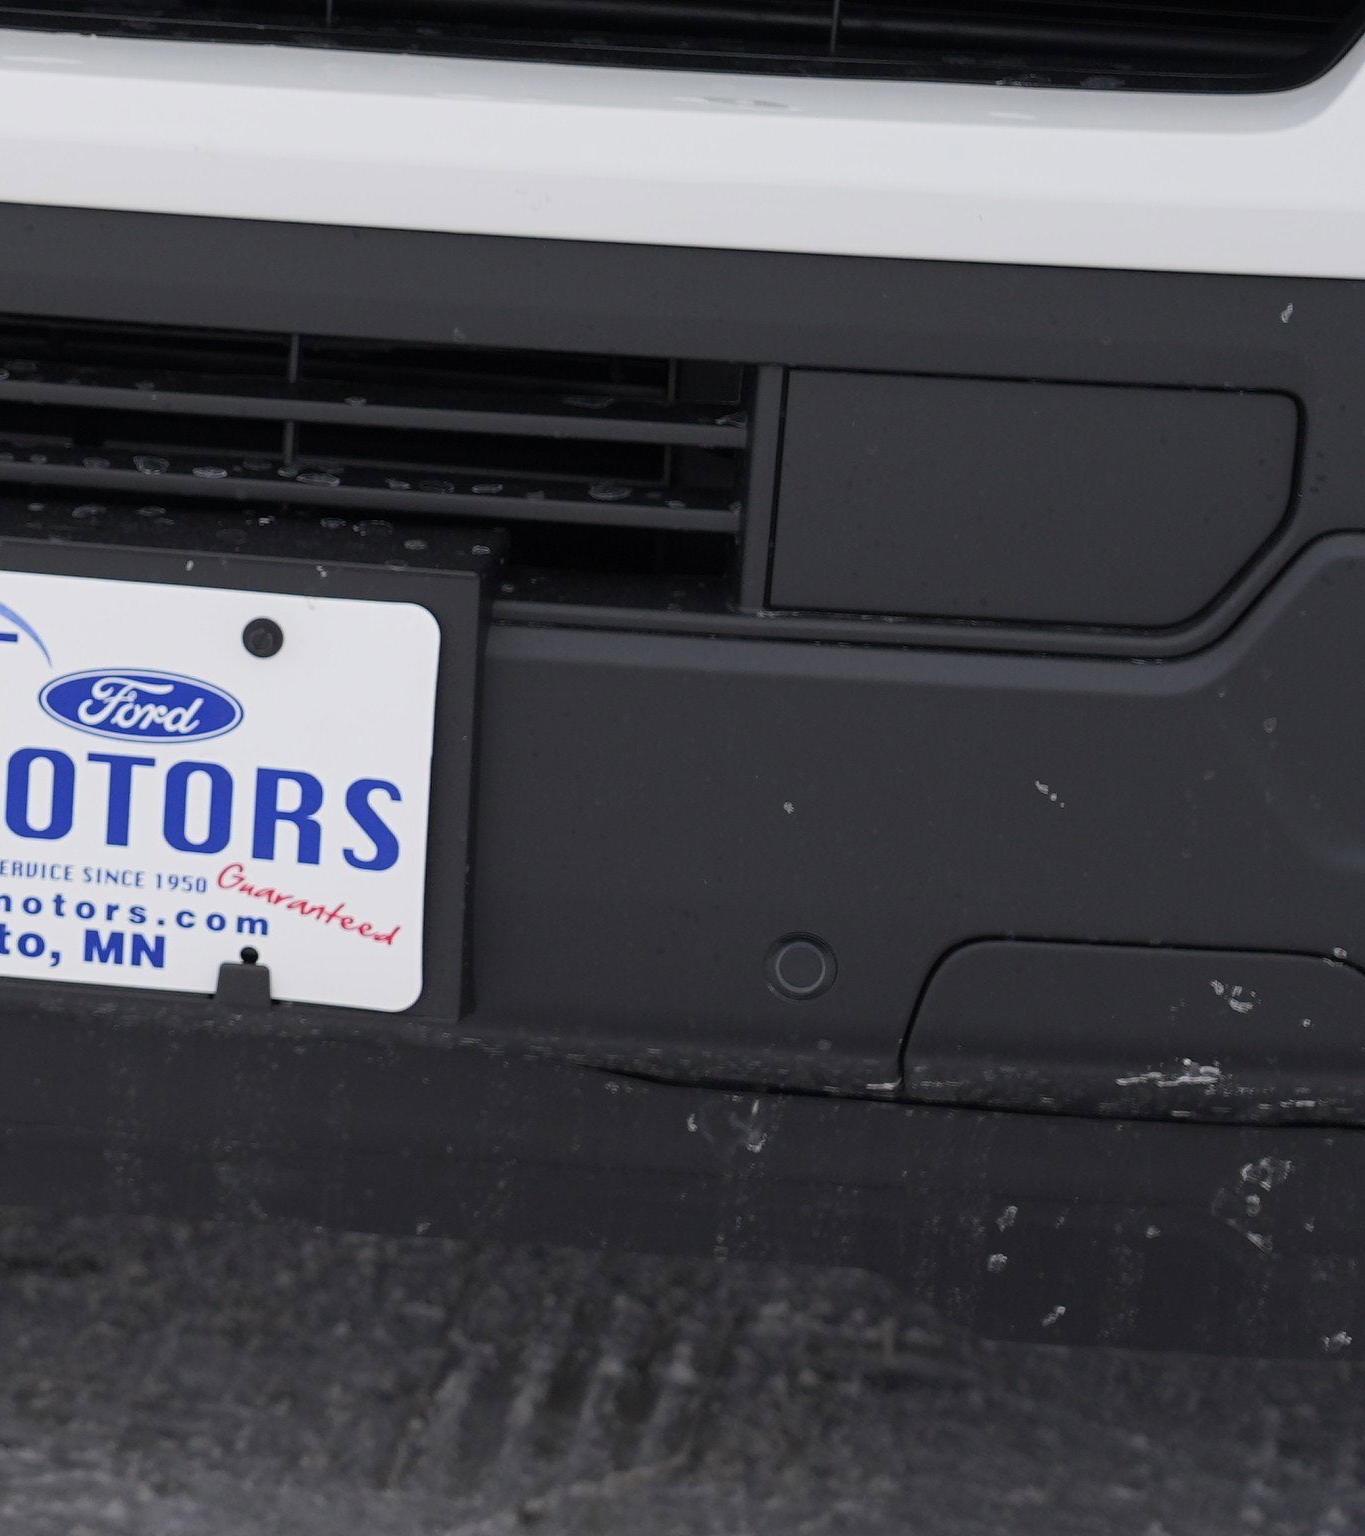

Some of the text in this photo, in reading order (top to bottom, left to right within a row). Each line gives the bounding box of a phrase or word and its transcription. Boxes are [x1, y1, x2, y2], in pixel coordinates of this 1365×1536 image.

[76, 676, 206, 736] Ford
[82, 866, 146, 888] SINCE
[155, 872, 209, 894] 1950
[216, 861, 402, 946] Guaranteed
[82, 928, 167, 969] MN
